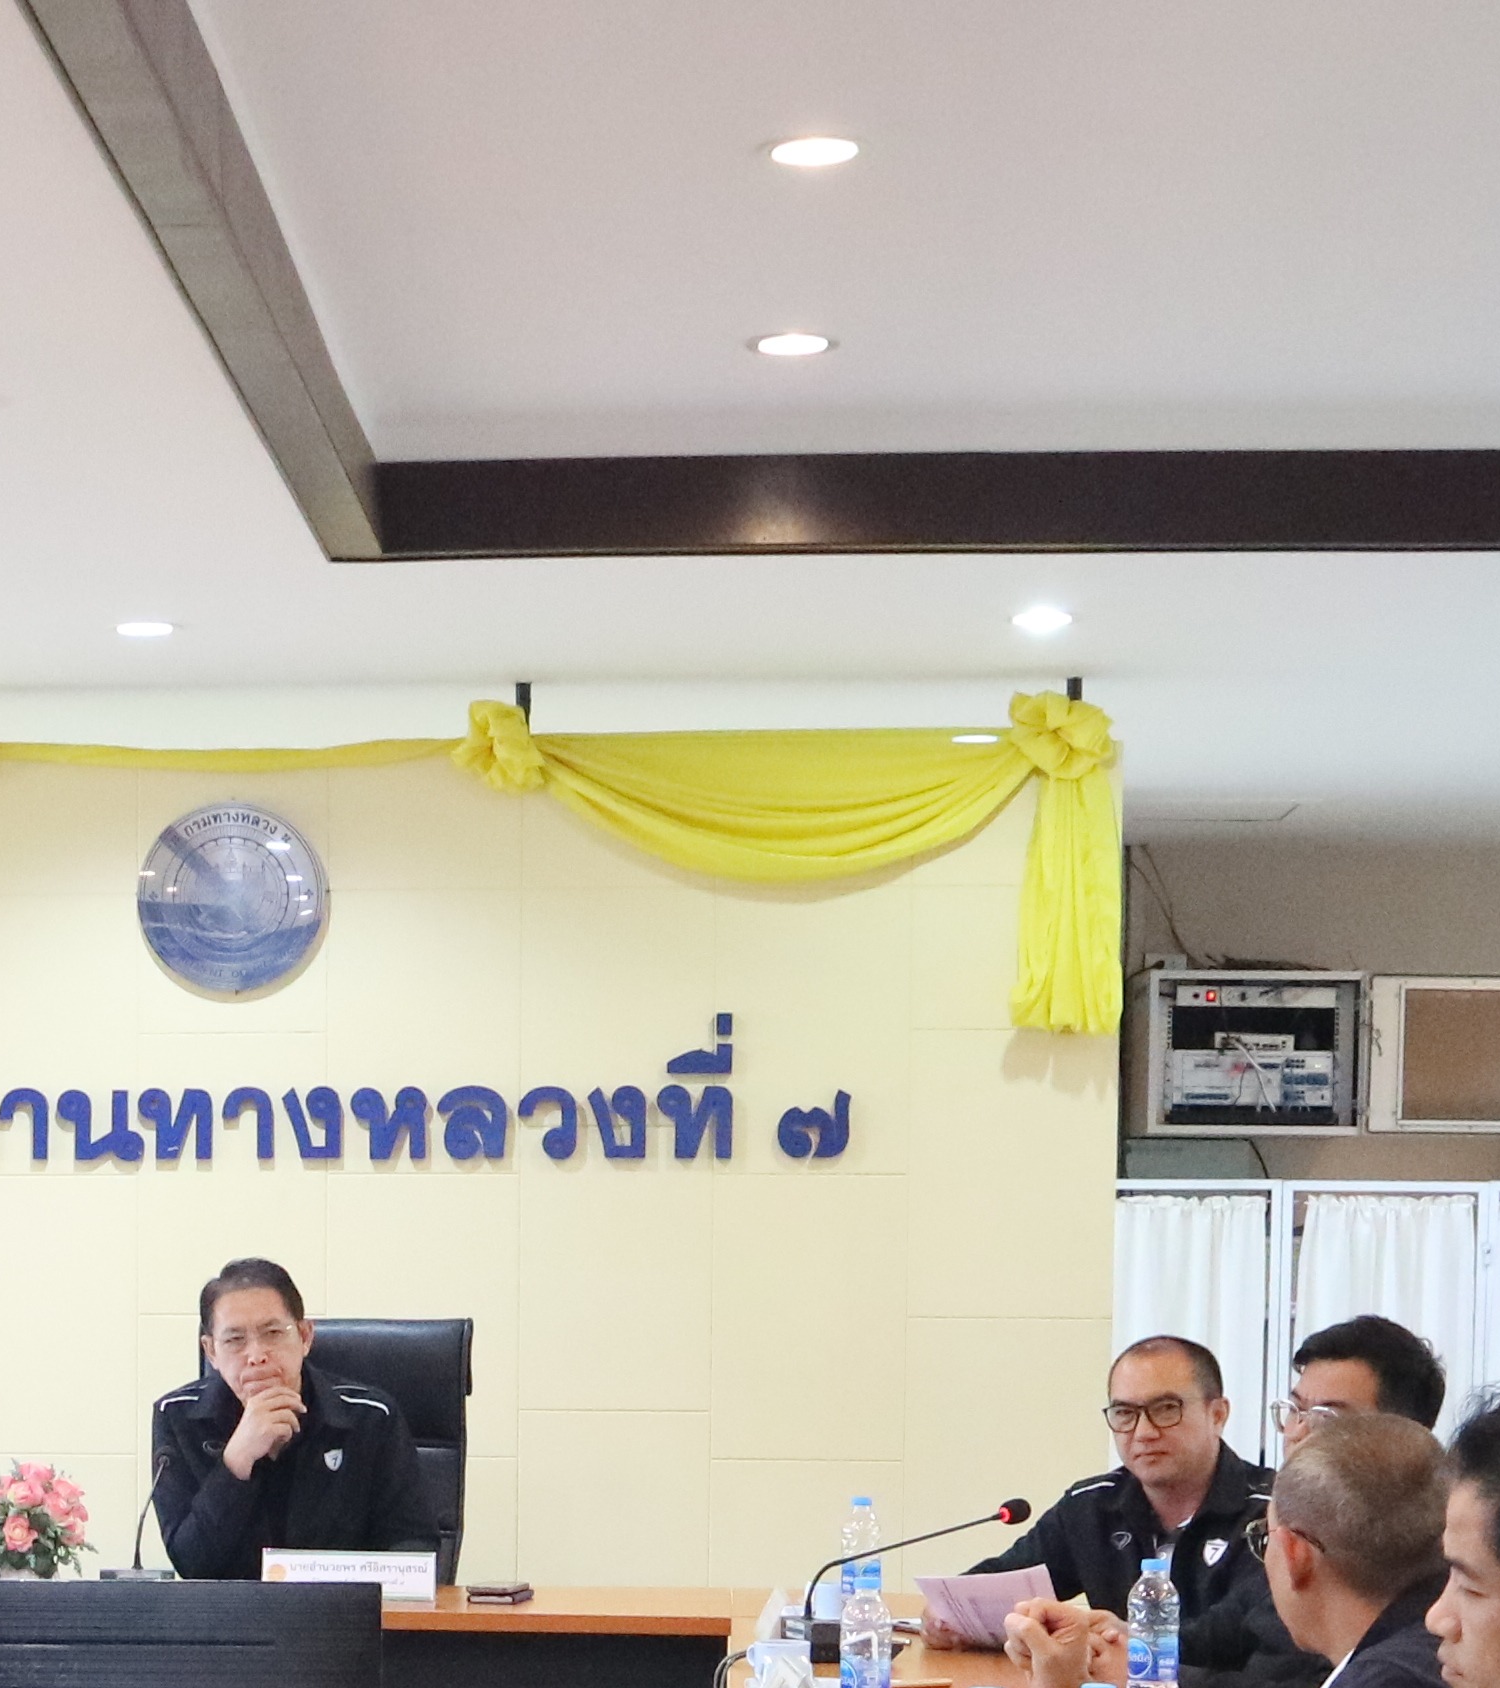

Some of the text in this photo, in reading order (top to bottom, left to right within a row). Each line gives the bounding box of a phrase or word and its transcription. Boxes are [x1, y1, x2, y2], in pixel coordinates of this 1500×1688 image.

[183, 810, 278, 838] กรมทางหลวง
[777, 1089, 851, 1158] ๗
